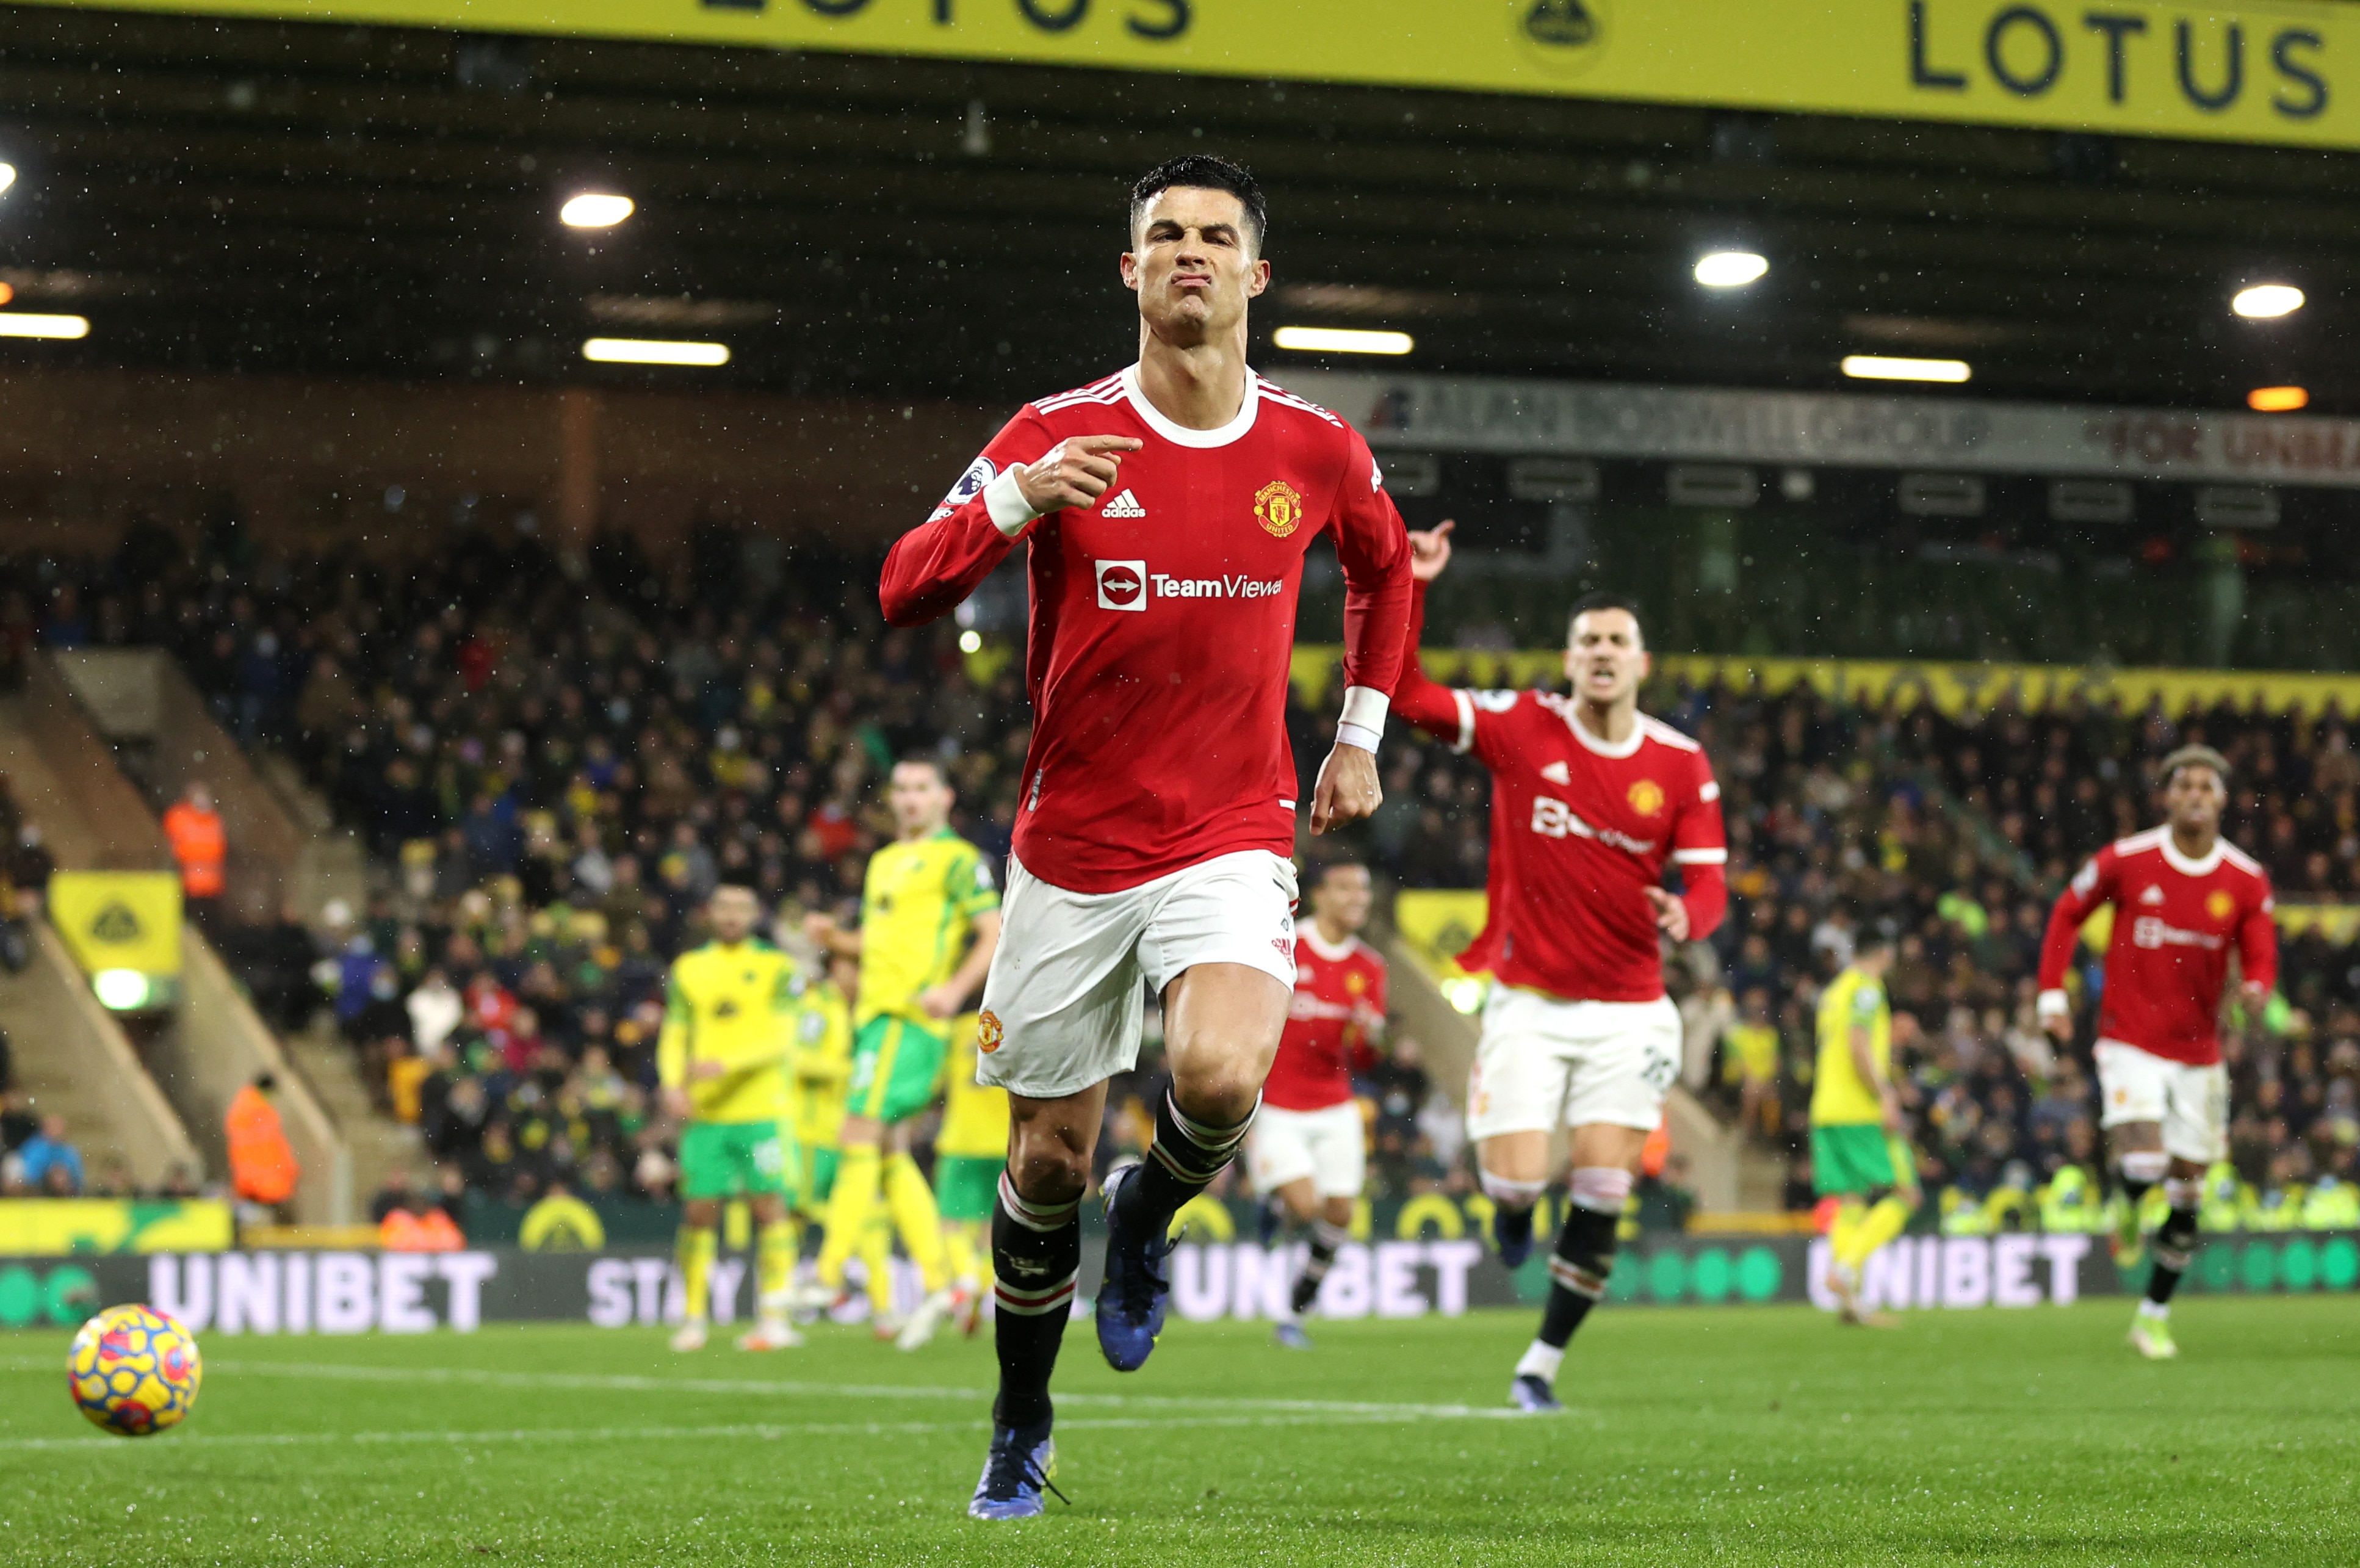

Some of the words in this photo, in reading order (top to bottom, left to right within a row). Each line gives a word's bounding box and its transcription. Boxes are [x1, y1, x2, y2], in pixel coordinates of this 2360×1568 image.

[1909, 0, 2329, 120] LOTUS
[1259, 485, 1297, 504] MANCHESTER
[1102, 507, 1146, 518] adidas
[1266, 523, 1293, 533] UNITED
[148, 1250, 497, 1335] UNIBET
